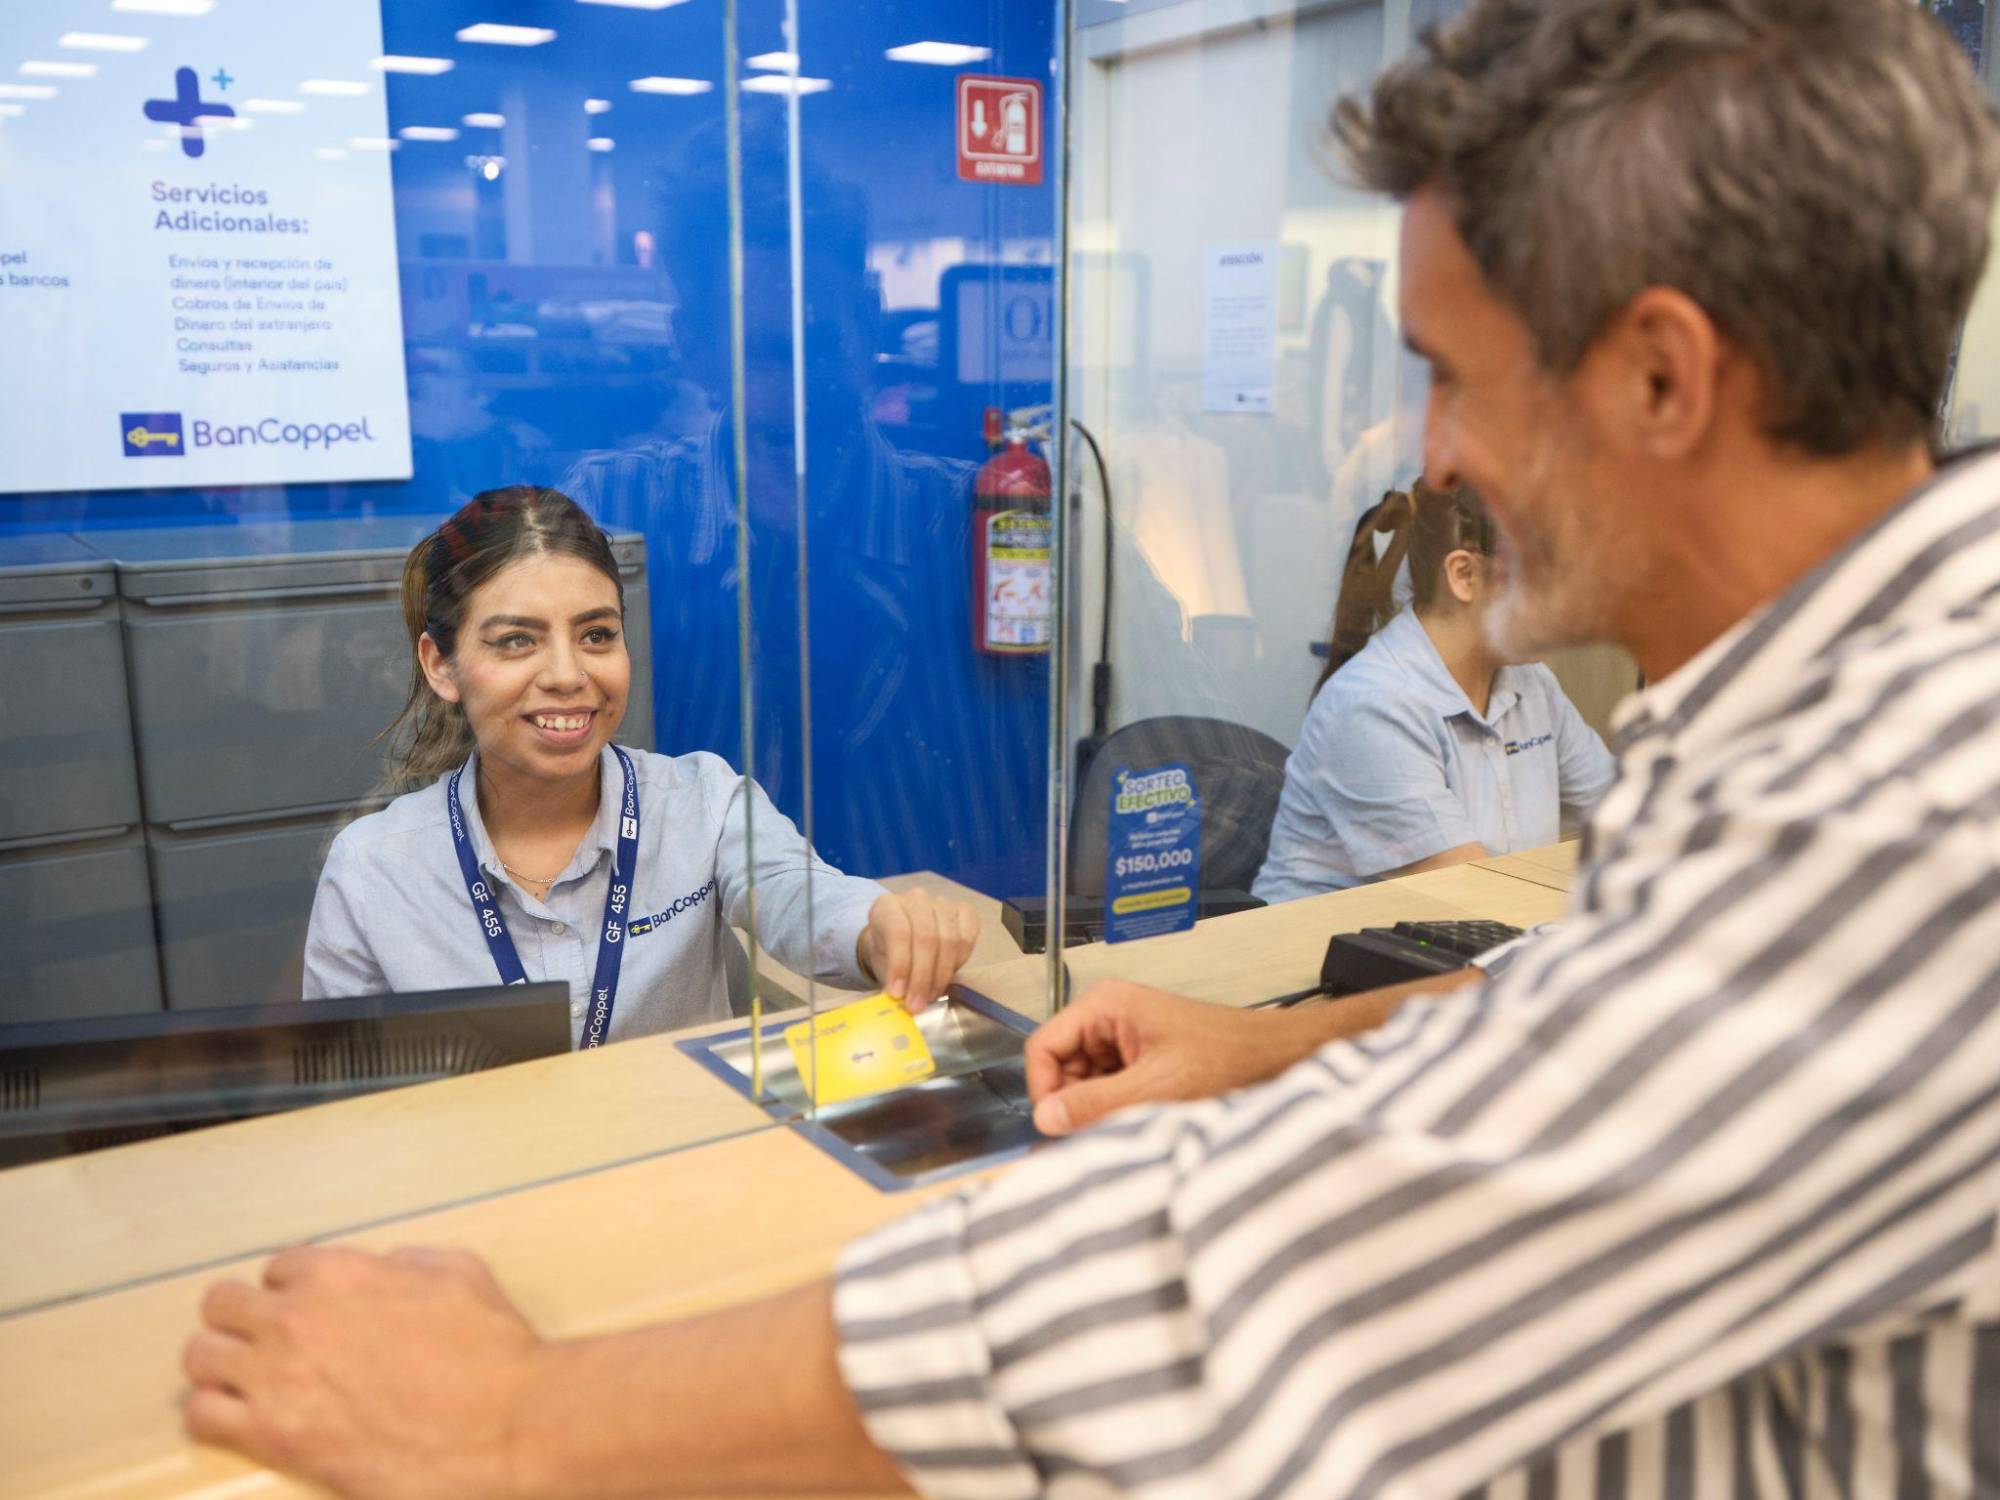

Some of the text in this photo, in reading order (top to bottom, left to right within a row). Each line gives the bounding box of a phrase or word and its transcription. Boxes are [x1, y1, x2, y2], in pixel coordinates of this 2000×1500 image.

[151, 180, 269, 205] Servicios
[155, 210, 311, 234] Adicionales:
[9, 271, 71, 287] bancos
[170, 274, 221, 290] dinero
[192, 416, 376, 451] BanCoppel
[1124, 771, 1186, 795] SORTEO
[1118, 786, 1190, 811] EFECTIVO
[1115, 849, 1192, 877] $150,000
[471, 881, 503, 938] GF 455
[606, 884, 627, 943] GF 455
[651, 880, 716, 929] BanCoppe
[588, 985, 609, 1051] anCoppel
